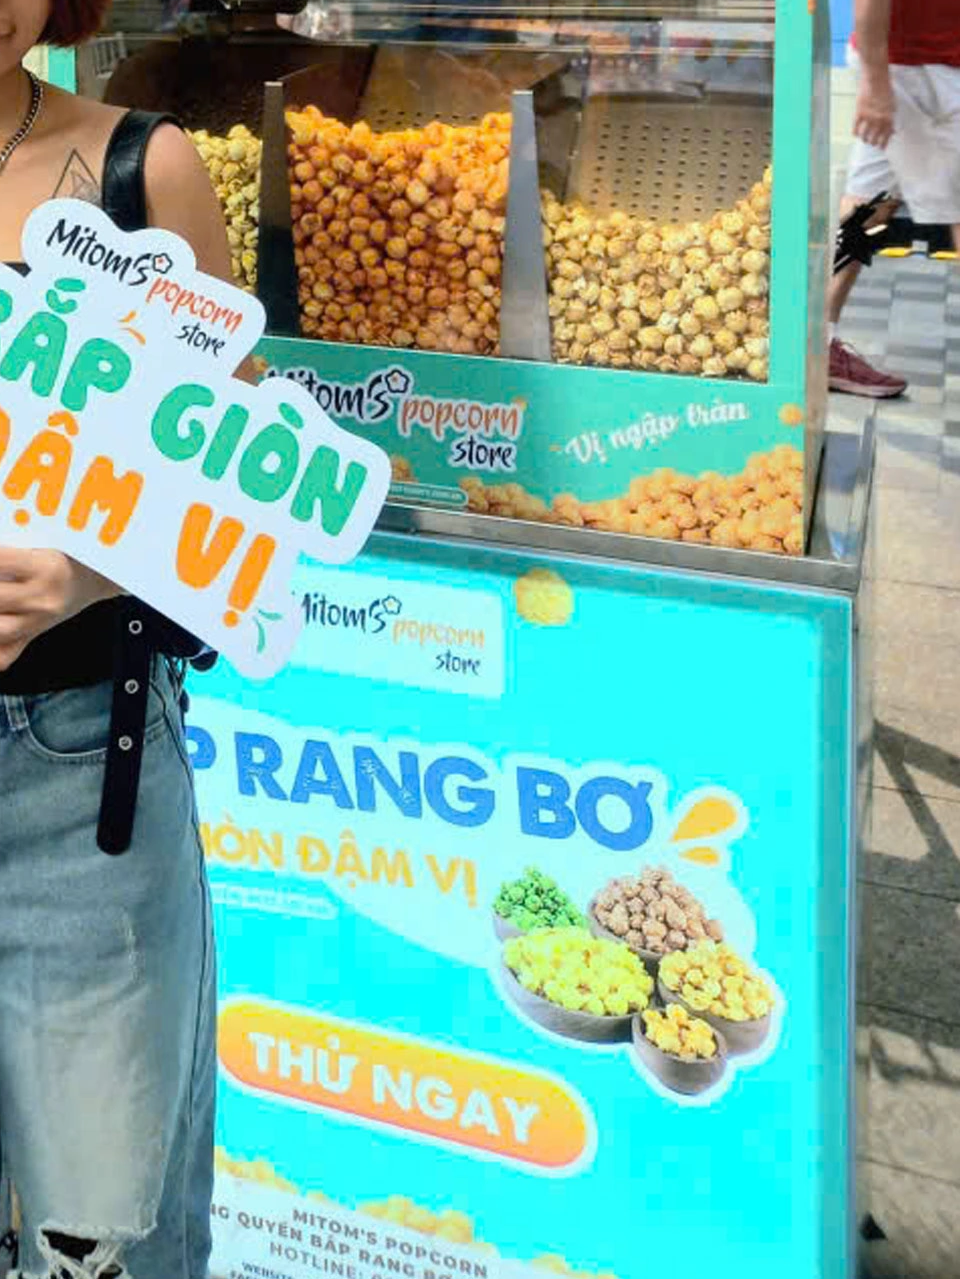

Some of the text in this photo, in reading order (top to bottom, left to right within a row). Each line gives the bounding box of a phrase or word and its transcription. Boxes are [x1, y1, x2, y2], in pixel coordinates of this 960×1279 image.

[144, 277, 243, 332] popcorn
[177, 323, 227, 357] store
[401, 397, 521, 436] popcorn
[564, 397, 750, 464] Vị ngập tràn
[150, 381, 368, 538] GIÒN
[453, 434, 515, 468] store
[174, 501, 277, 628] VỊ
[393, 619, 485, 648] popcorn
[435, 650, 482, 676] store
[233, 730, 496, 828] RANG
[515, 765, 654, 853] BƠ
[200, 811, 478, 909] IÒN ĐẬM VỊ
[246, 1030, 540, 1145] THỬ NGAY
[292, 1208, 488, 1278] MITOM'S POPCORN
[358, 1249, 415, 1278] RANG
